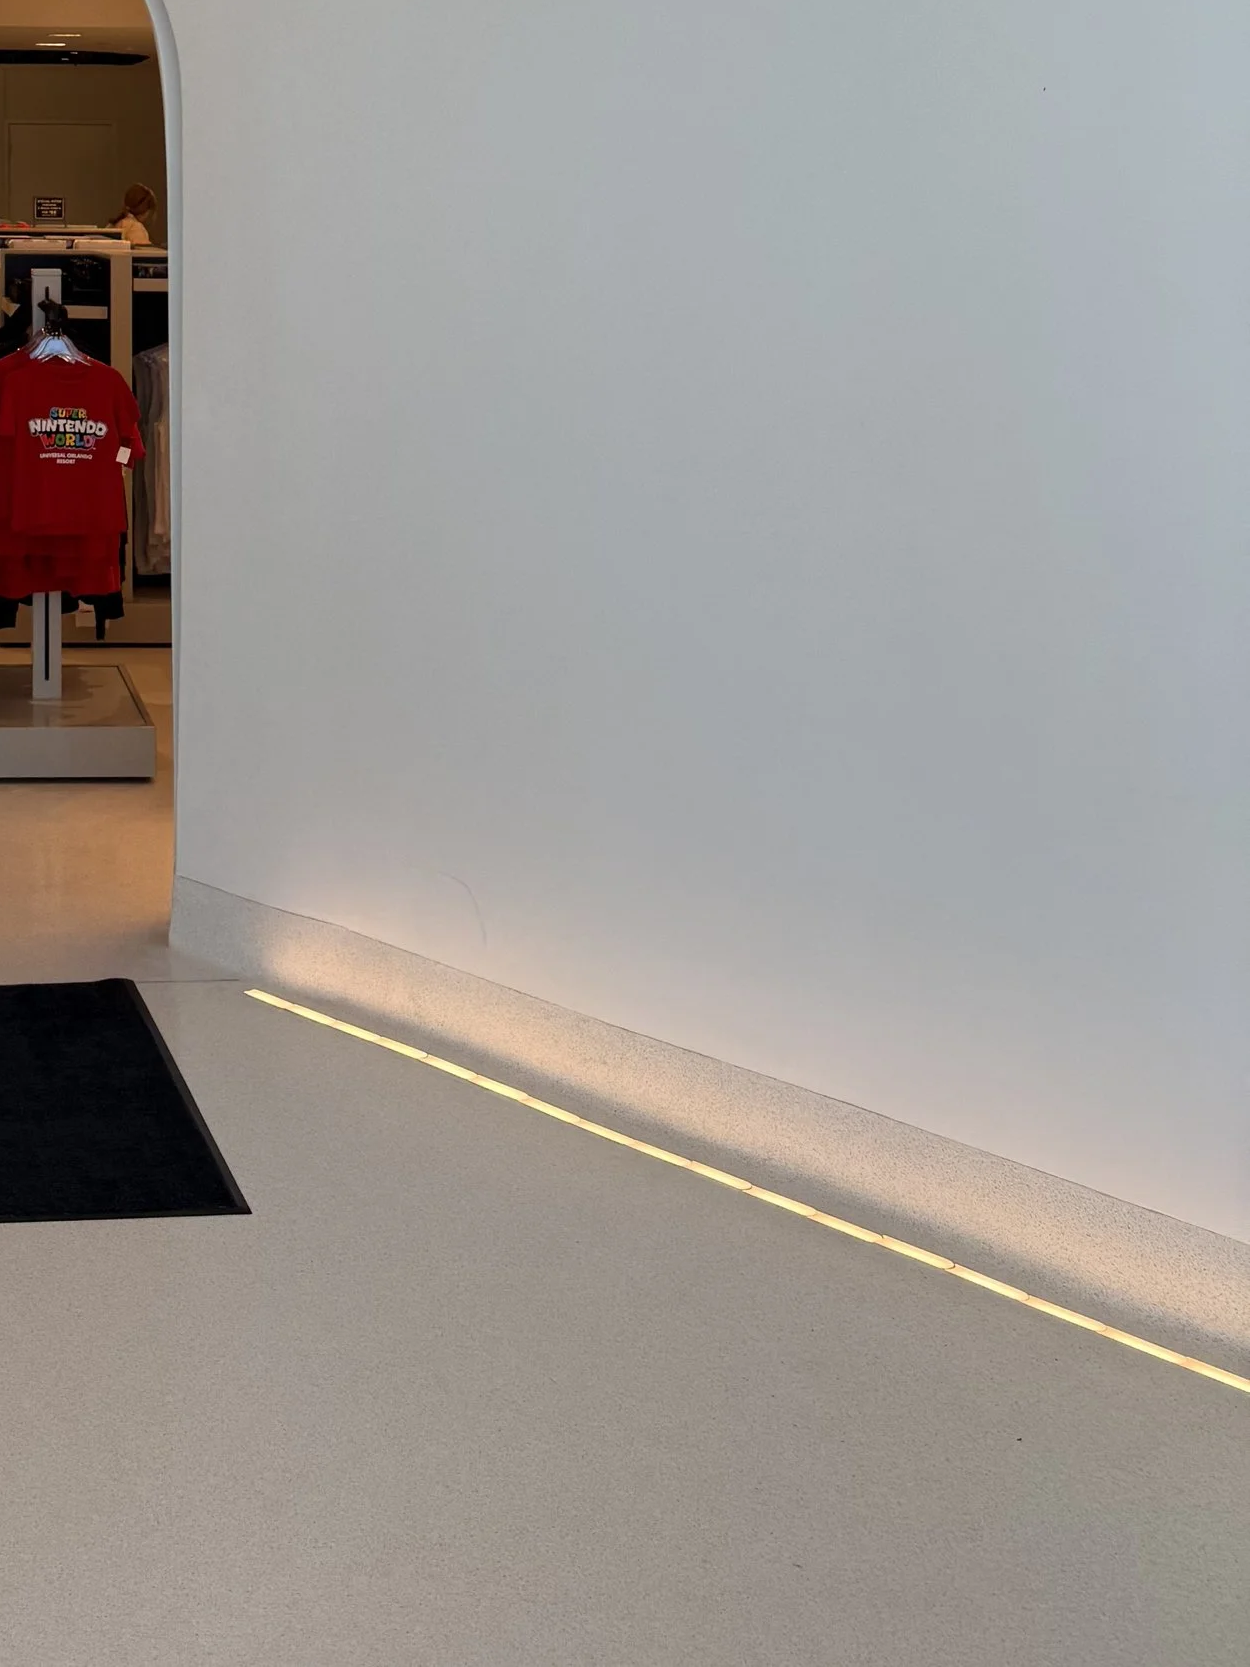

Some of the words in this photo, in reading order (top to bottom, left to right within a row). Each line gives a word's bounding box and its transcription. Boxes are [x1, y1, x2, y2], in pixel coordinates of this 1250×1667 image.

[50, 407, 87, 419] SUPER
[28, 418, 107, 437] NINTENDO
[40, 433, 96, 449] WORLD
